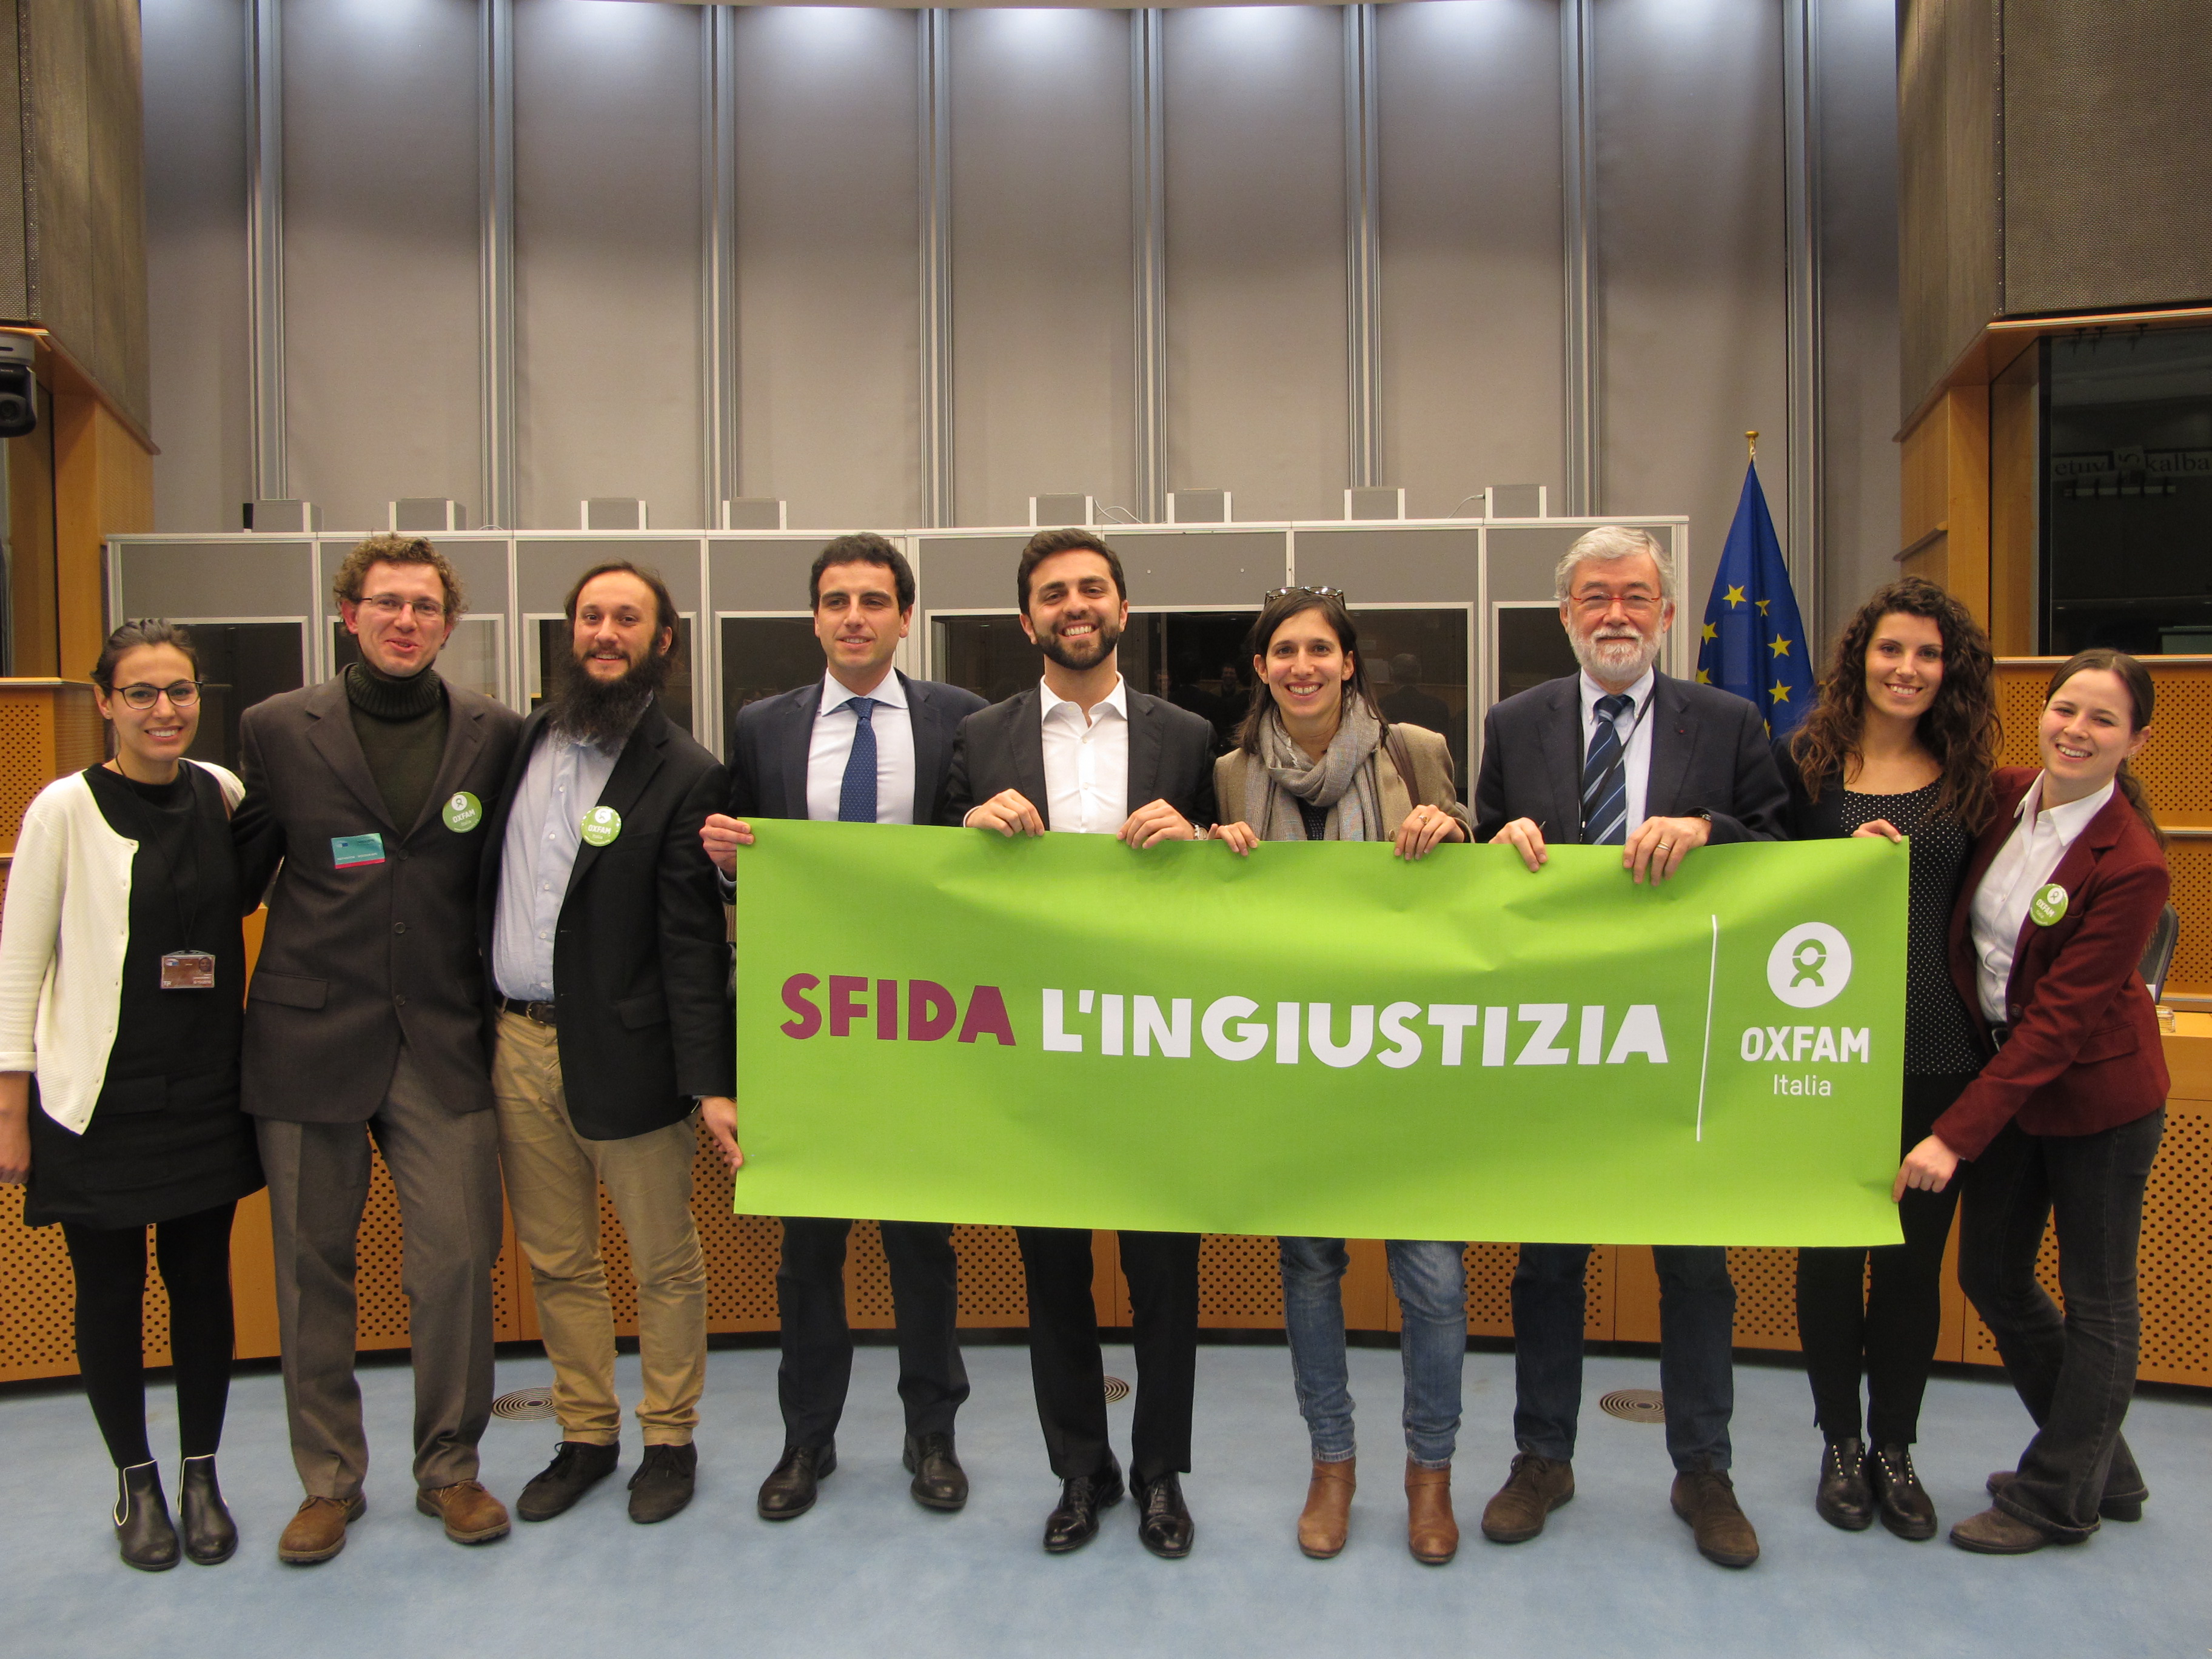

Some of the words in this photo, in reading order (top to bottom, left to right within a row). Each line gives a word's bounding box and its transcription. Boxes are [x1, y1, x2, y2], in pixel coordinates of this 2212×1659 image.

[2145, 452, 2211, 474] kalba
[452, 809, 476, 823] OXFAM
[588, 824, 612, 835] OXFAM
[2036, 898, 2055, 917] OXFAM
[780, 973, 1016, 1047] SFIDA
[1042, 987, 1669, 1068] L'INGIUSTIZIA
[1740, 1026, 1869, 1063] OXFAM
[1773, 1074, 1832, 1096] Italia
